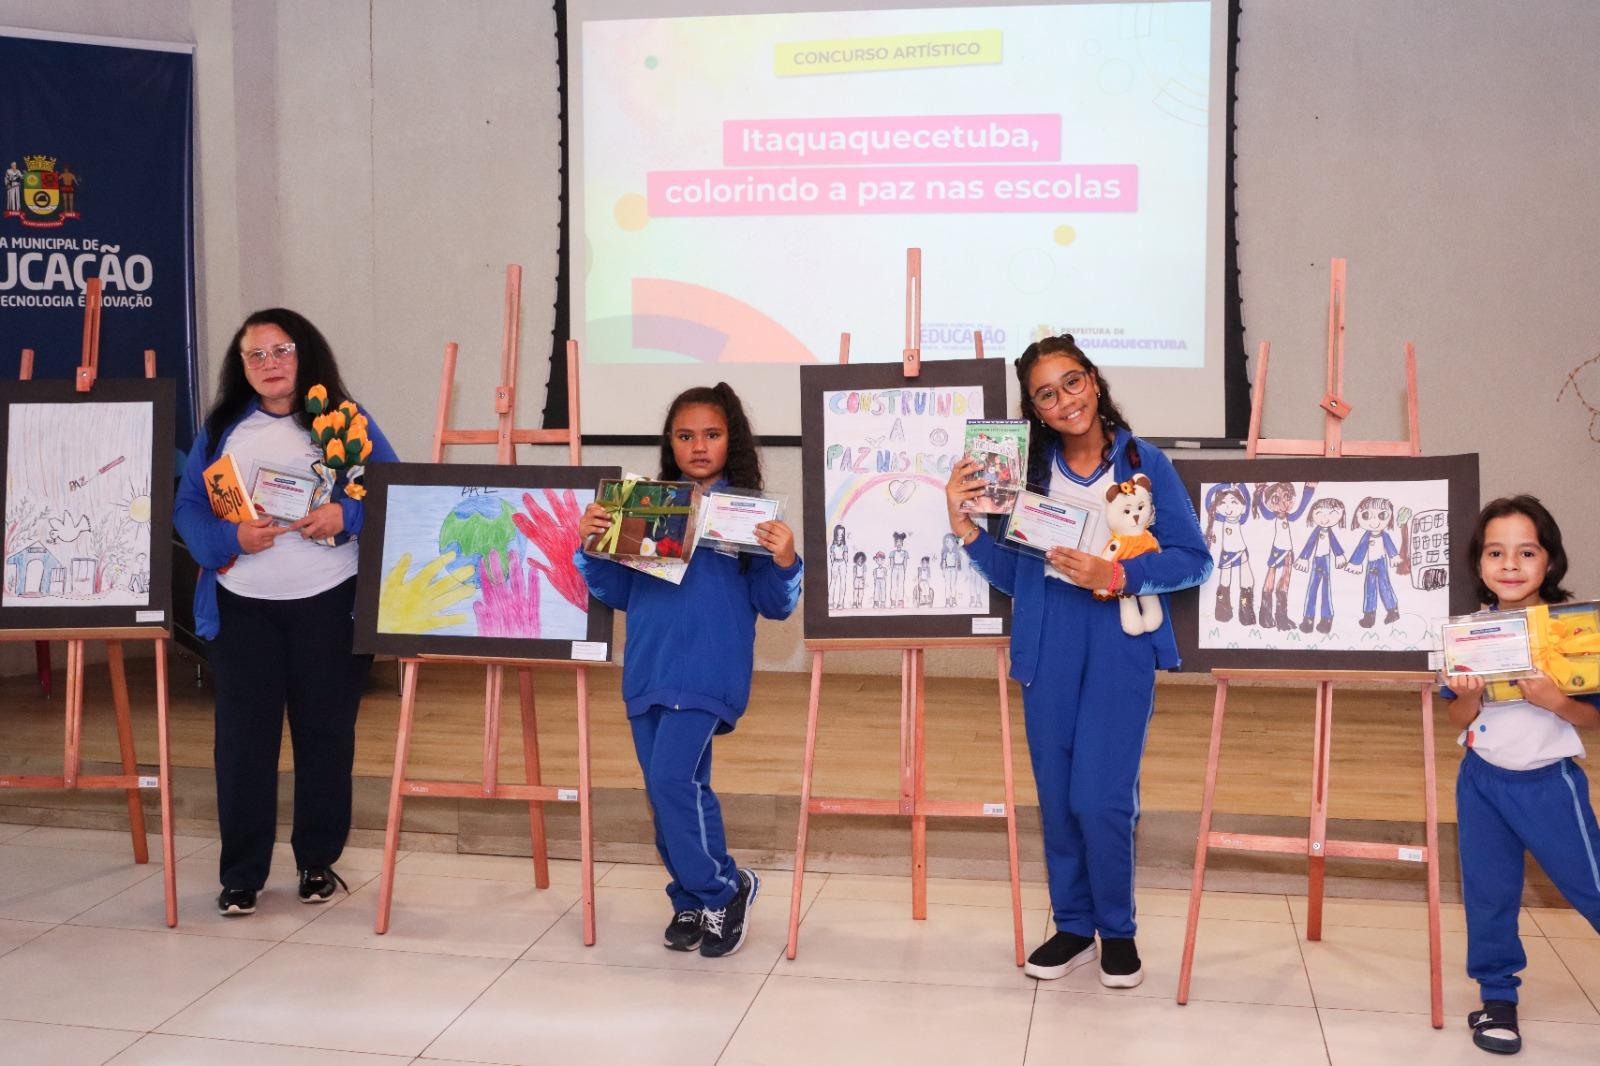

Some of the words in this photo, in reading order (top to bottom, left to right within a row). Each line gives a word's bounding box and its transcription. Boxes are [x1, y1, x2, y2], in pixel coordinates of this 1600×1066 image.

[793, 47, 889, 65] CONCURSO
[892, 42, 981, 60] ARTÍSTICO
[742, 122, 1039, 158] Itaquaquecetuba,
[665, 174, 818, 206] colorindo
[829, 181, 846, 201] a
[858, 180, 915, 207] paz
[927, 178, 984, 200] nas
[994, 173, 1121, 200] escolas
[12, 237, 79, 250] MUNICIPAL
[83, 239, 99, 251] DE
[1, 294, 74, 308] ECNOLOGIA
[101, 293, 152, 310] OVAÇÃO
[921, 326, 1006, 344] EDUCAÃO
[829, 389, 981, 418] CONSTRUINDO
[889, 417, 905, 442] A
[826, 443, 872, 474] PAZ
[876, 449, 911, 473] NAS
